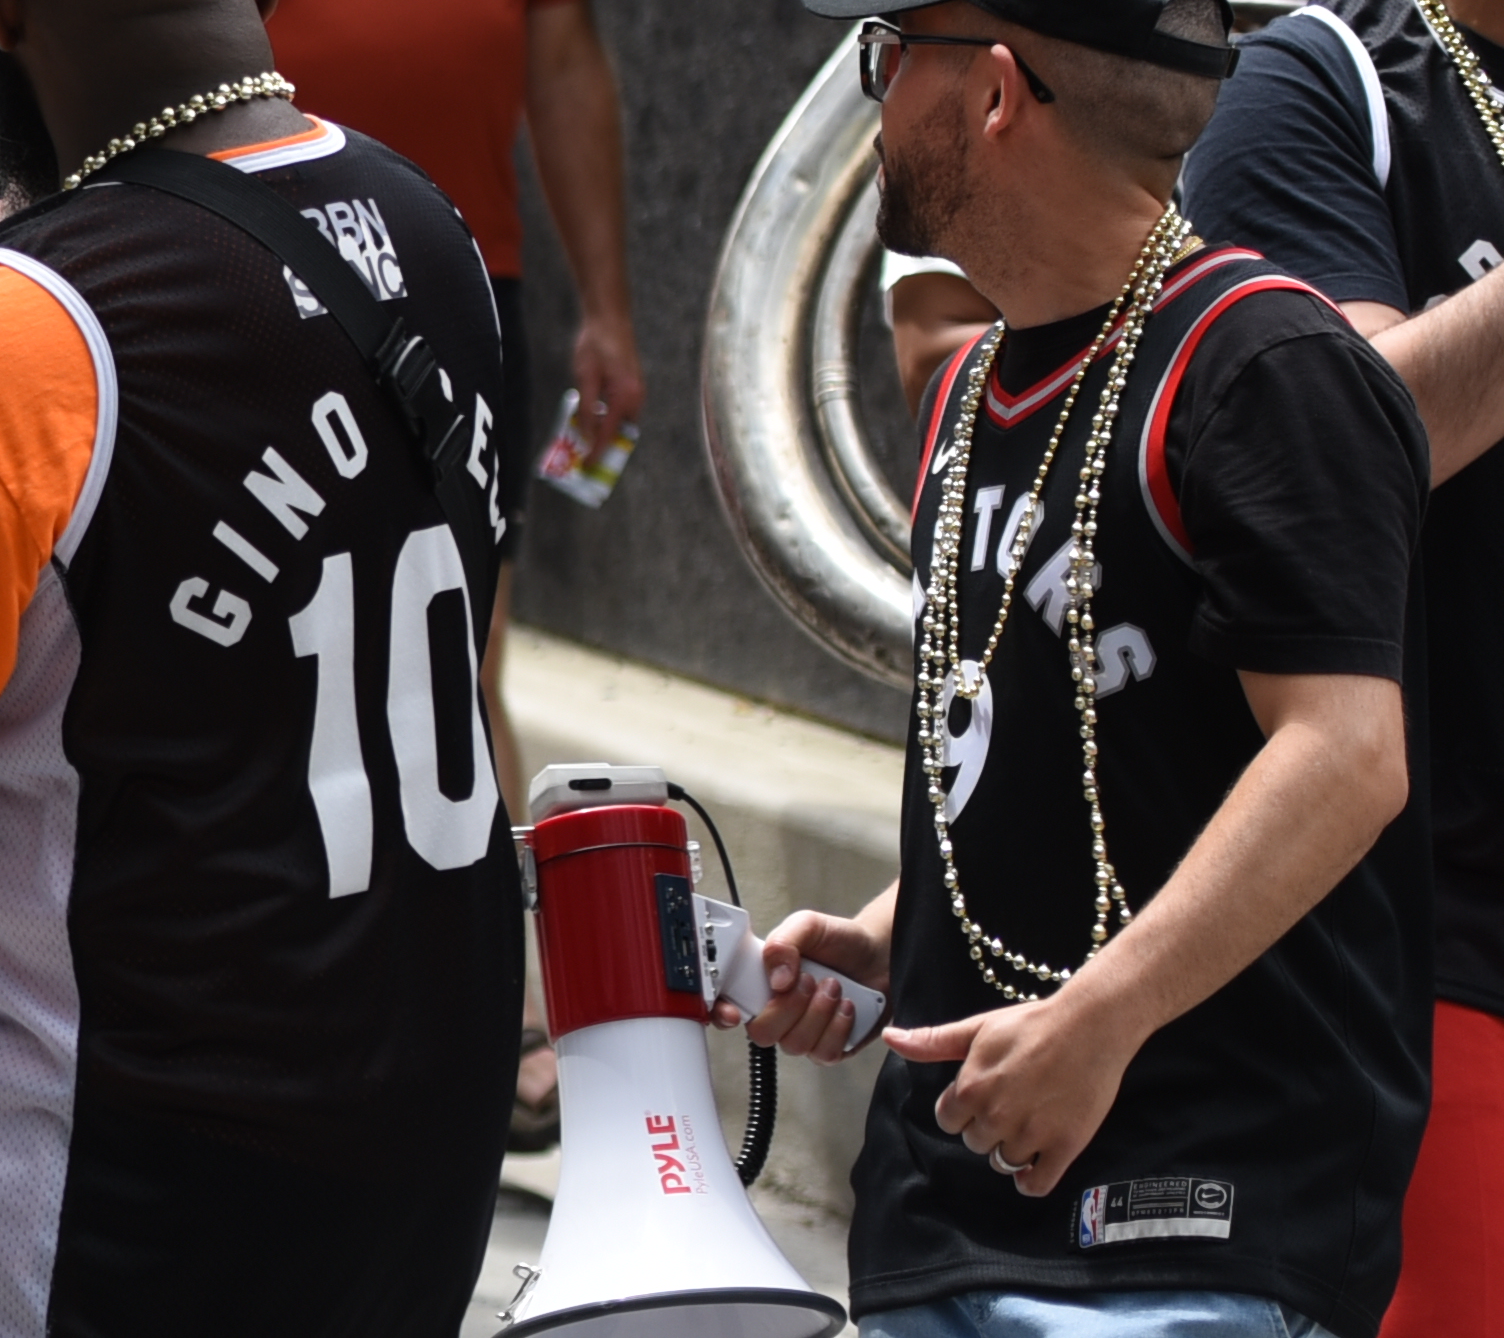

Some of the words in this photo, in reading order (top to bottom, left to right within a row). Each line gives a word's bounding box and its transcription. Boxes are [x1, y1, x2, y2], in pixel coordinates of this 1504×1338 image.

[169, 391, 369, 647] GINO
[288, 524, 500, 899] 10
[645, 1114, 692, 1195] PYLE
[681, 1114, 710, 1195] PyleUSA.com
